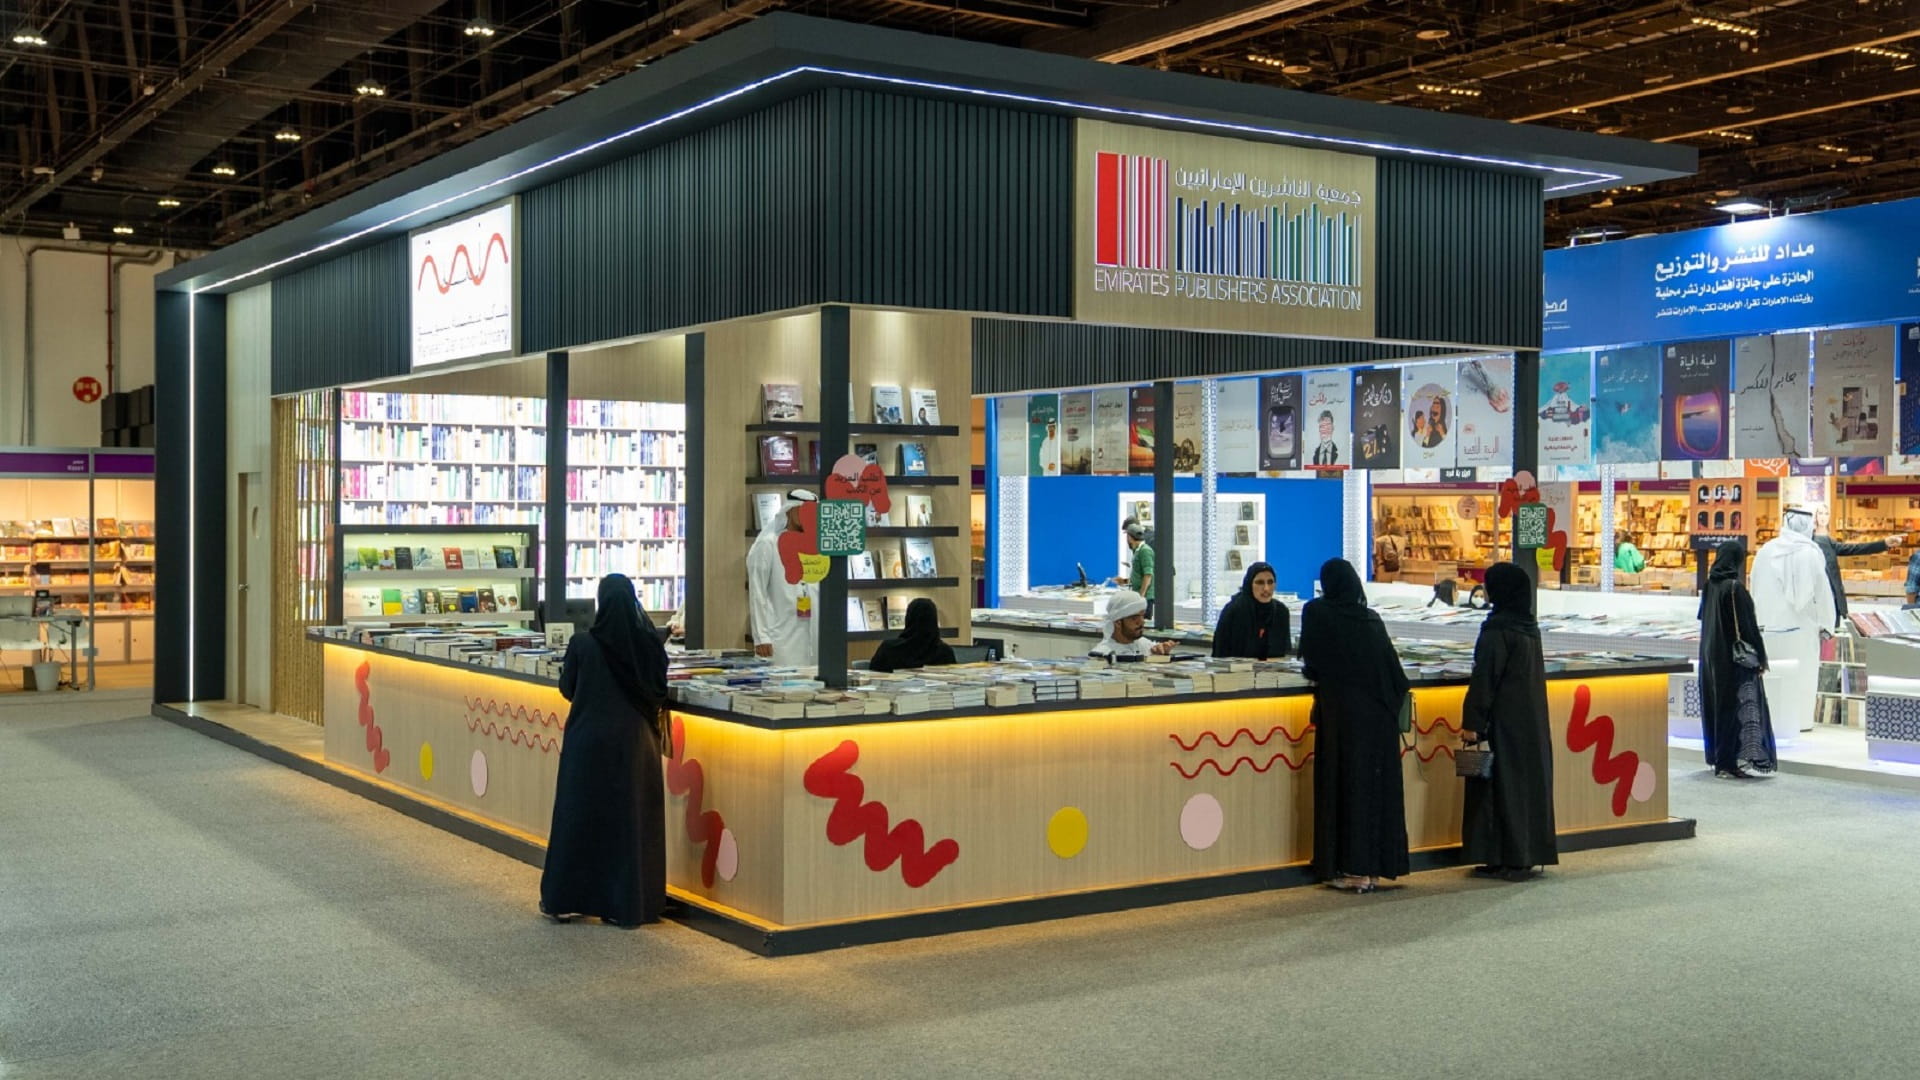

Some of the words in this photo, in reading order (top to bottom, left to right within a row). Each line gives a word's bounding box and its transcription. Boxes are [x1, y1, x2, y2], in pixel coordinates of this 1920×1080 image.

[1175, 167, 1247, 195] الإماراتيين
[1249, 174, 1313, 199] الناشرين
[1316, 183, 1362, 208] جمعية
[1719, 243, 1771, 272] للنشر
[1775, 242, 1815, 261] مداد
[1654, 251, 1719, 282] والتوزيع
[1094, 268, 1170, 297] EMIRATES
[1175, 274, 1268, 304] PUBLISHERS
[1271, 284, 1362, 311] ASSOCIATION
[1762, 273, 1781, 290] على
